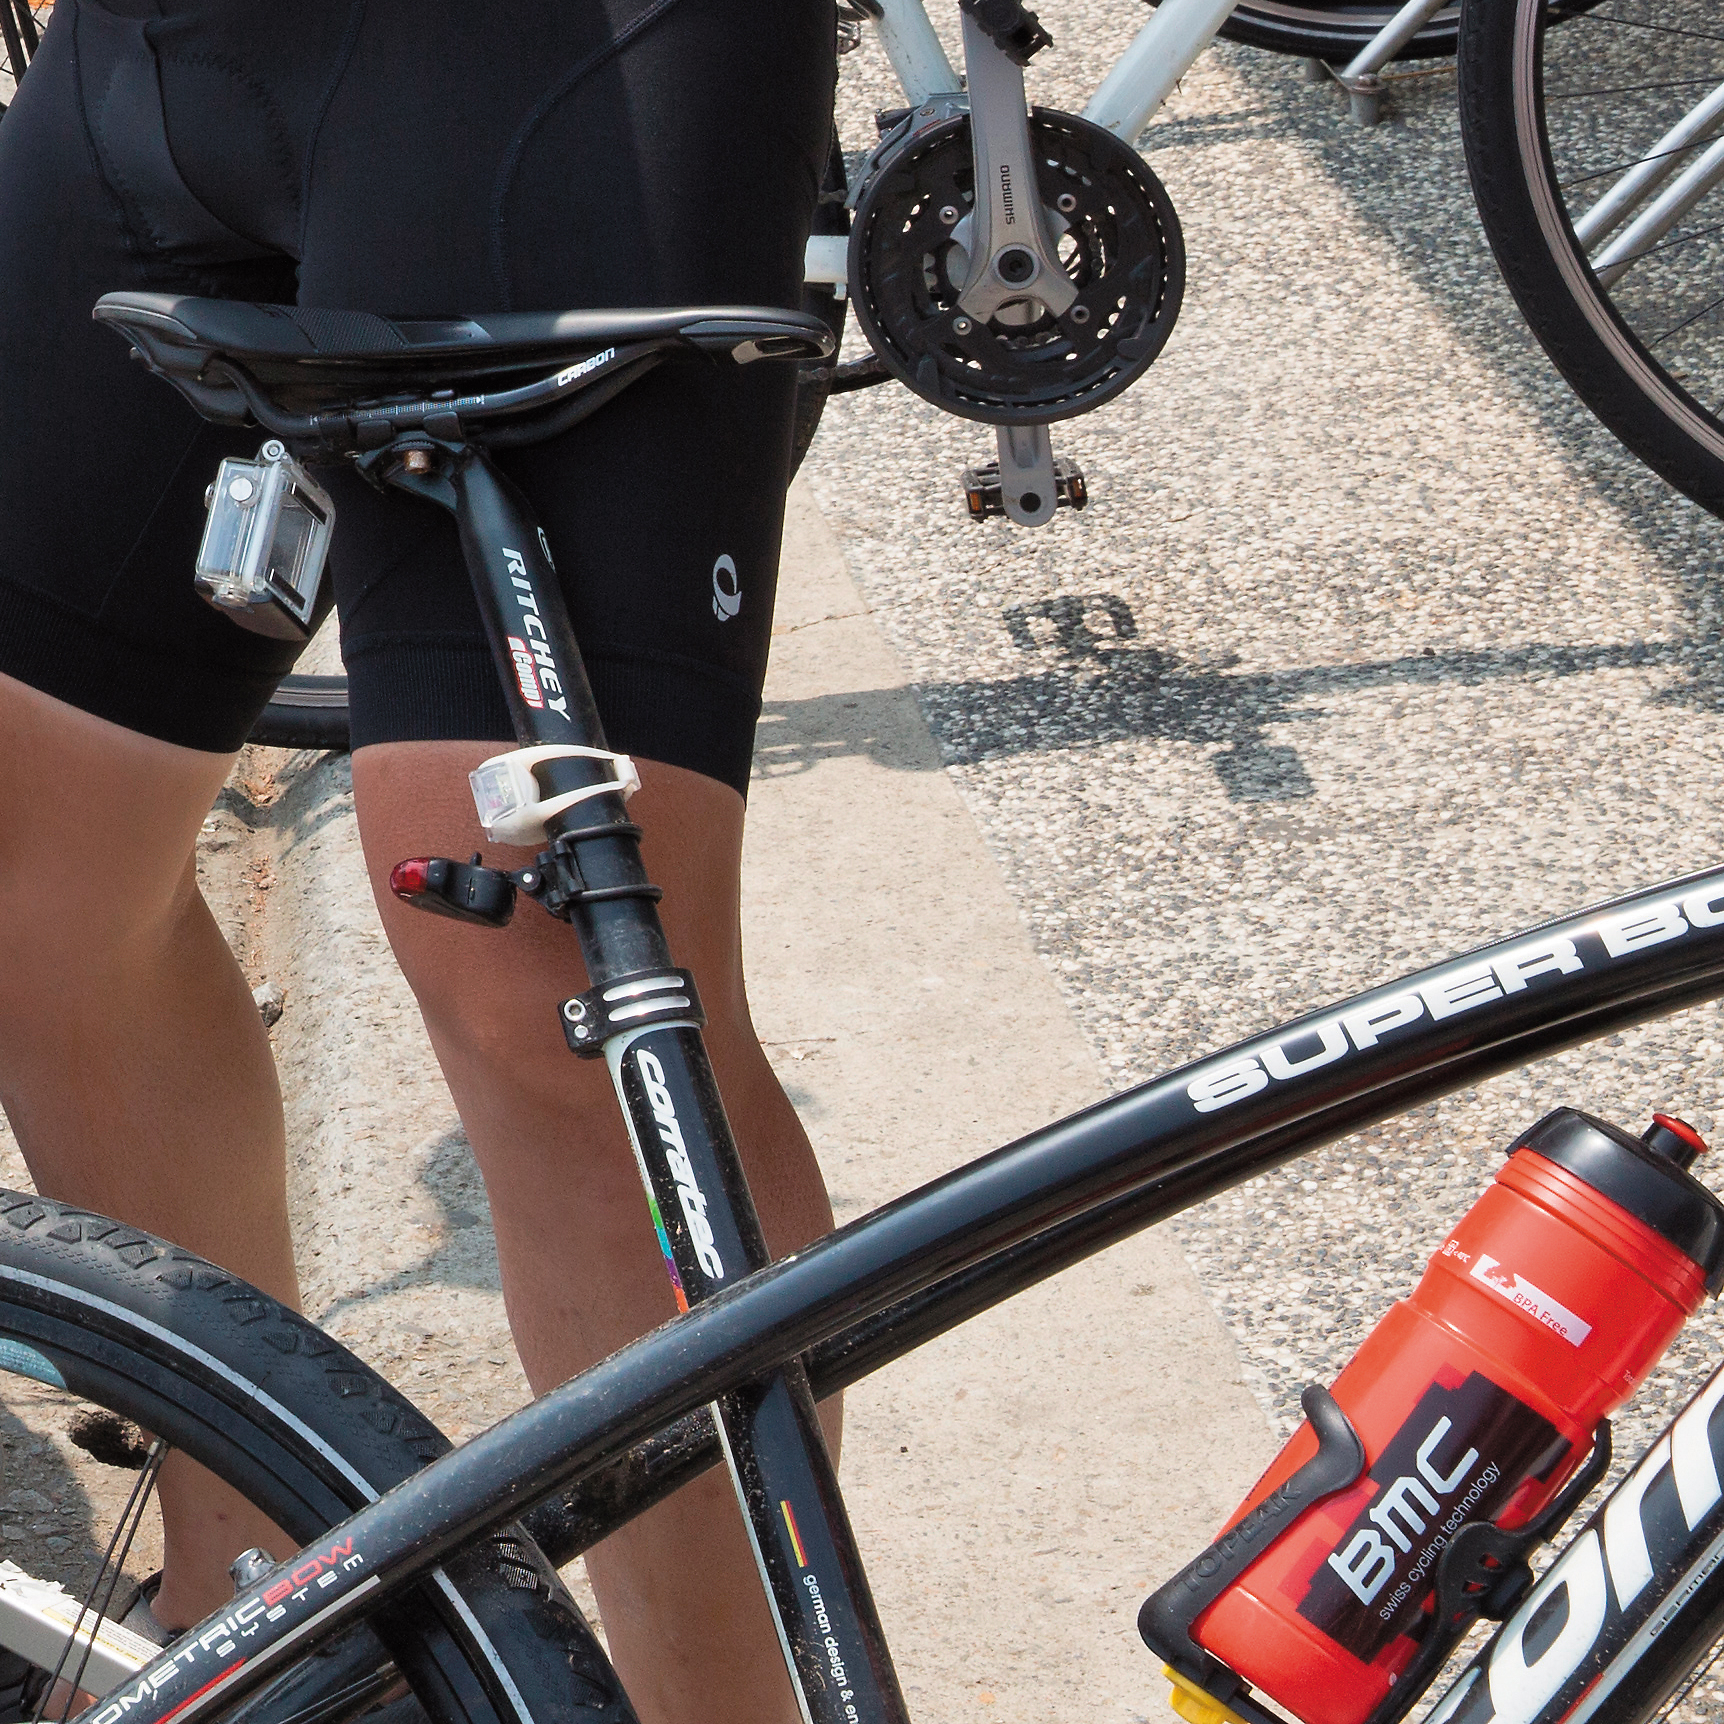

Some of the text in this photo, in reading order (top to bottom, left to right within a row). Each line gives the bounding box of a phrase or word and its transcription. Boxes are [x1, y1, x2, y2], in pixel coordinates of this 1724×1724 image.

[1003, 164, 1013, 226] SHIMANO
[557, 347, 617, 388] CARBON
[503, 547, 572, 723] RITCHEY
[1186, 935, 1586, 1115] SUPER
[1514, 1292, 1568, 1337] BPA Free
[1328, 1415, 1479, 1607] BMC
[1379, 1460, 1502, 1621] swiss cycling technology
[214, 1553, 364, 1660] SYSTEM
[803, 1574, 832, 1634] german
[824, 1636, 849, 1687] design
[840, 1689, 854, 1702] &
